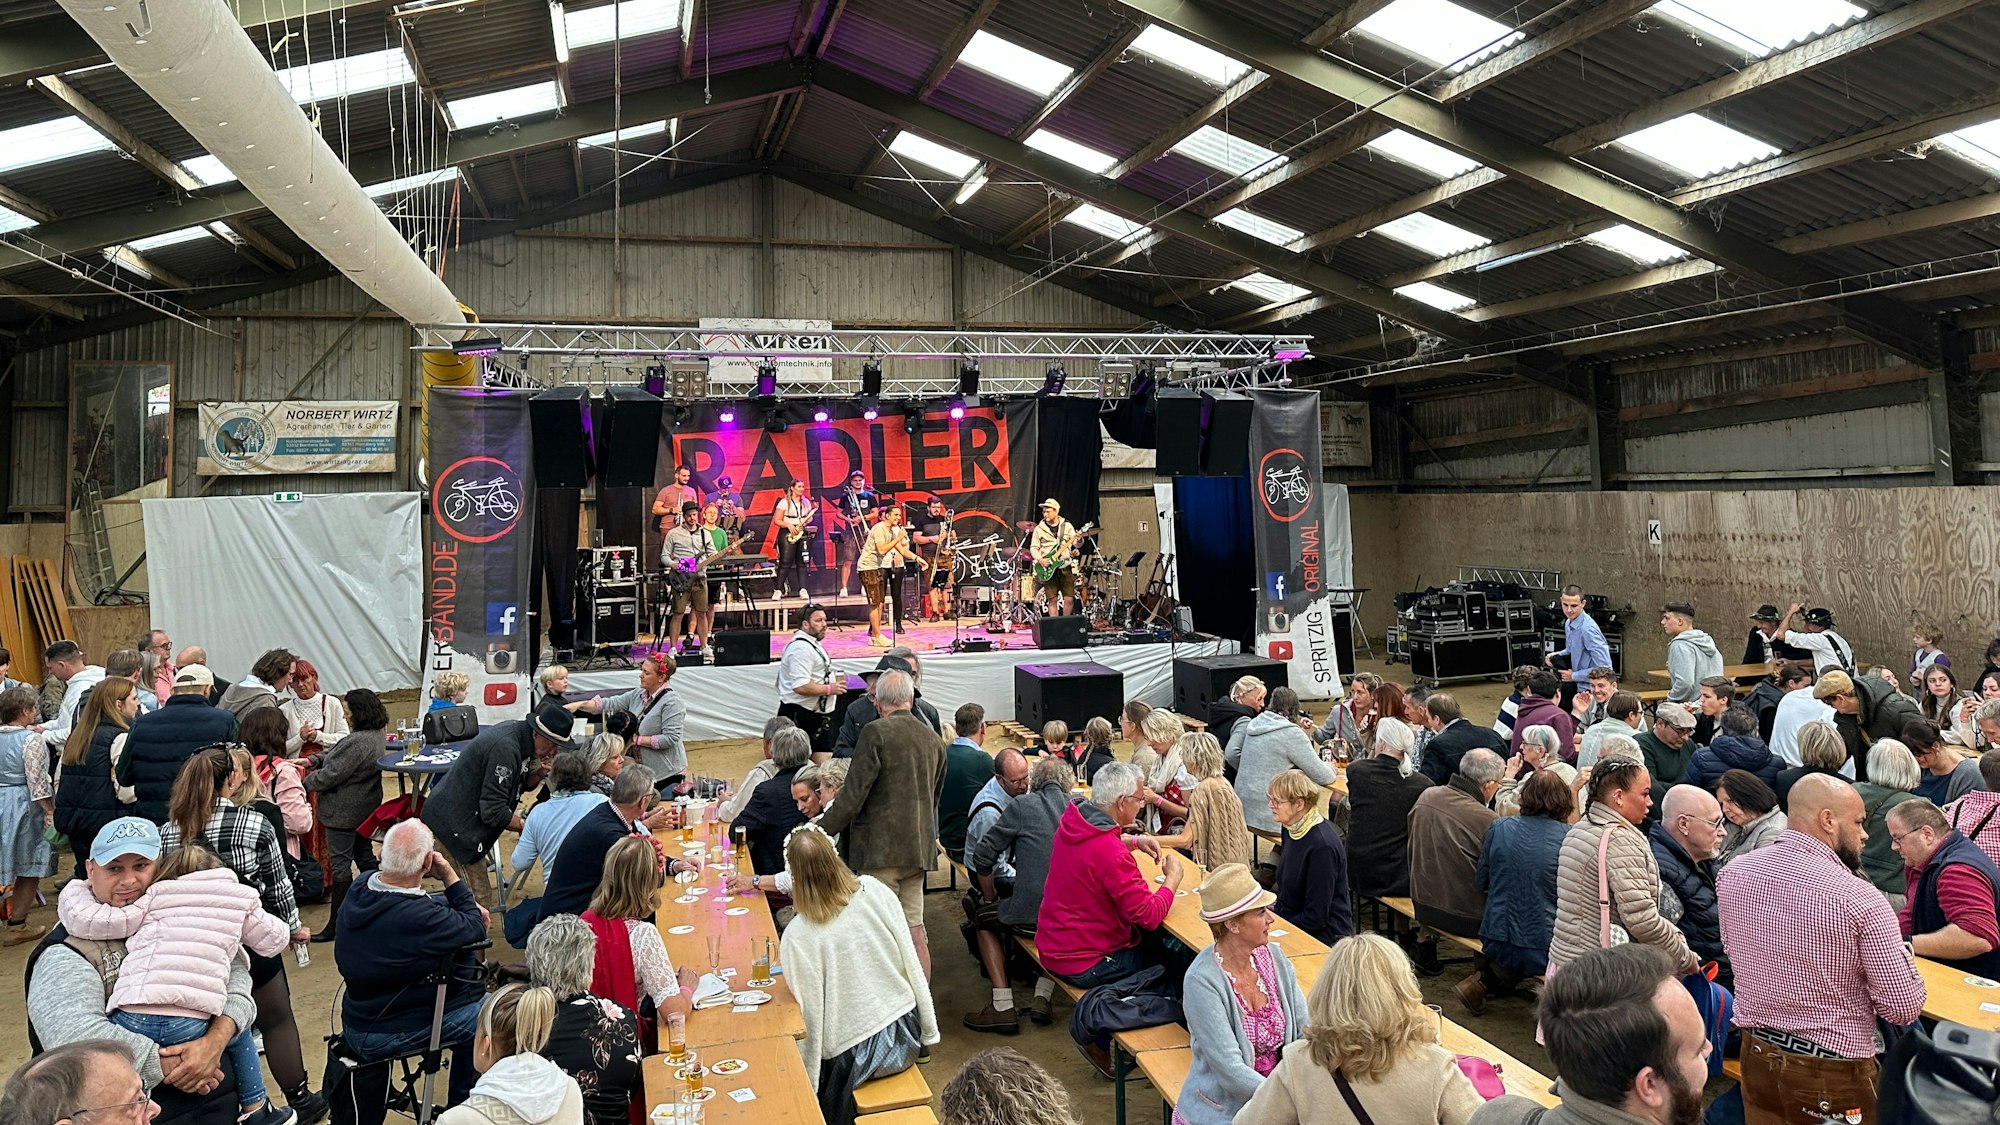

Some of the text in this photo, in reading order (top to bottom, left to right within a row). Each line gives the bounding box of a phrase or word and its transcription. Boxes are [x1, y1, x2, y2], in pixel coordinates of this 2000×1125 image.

[286, 410, 393, 420] NORBERT WIRTZ
[286, 422, 334, 431] Agrarhandel
[680, 415, 1008, 501] RADLER
[1649, 523, 1661, 541] K
[1301, 520, 1332, 683] SPRITZIG ORIGINAL
